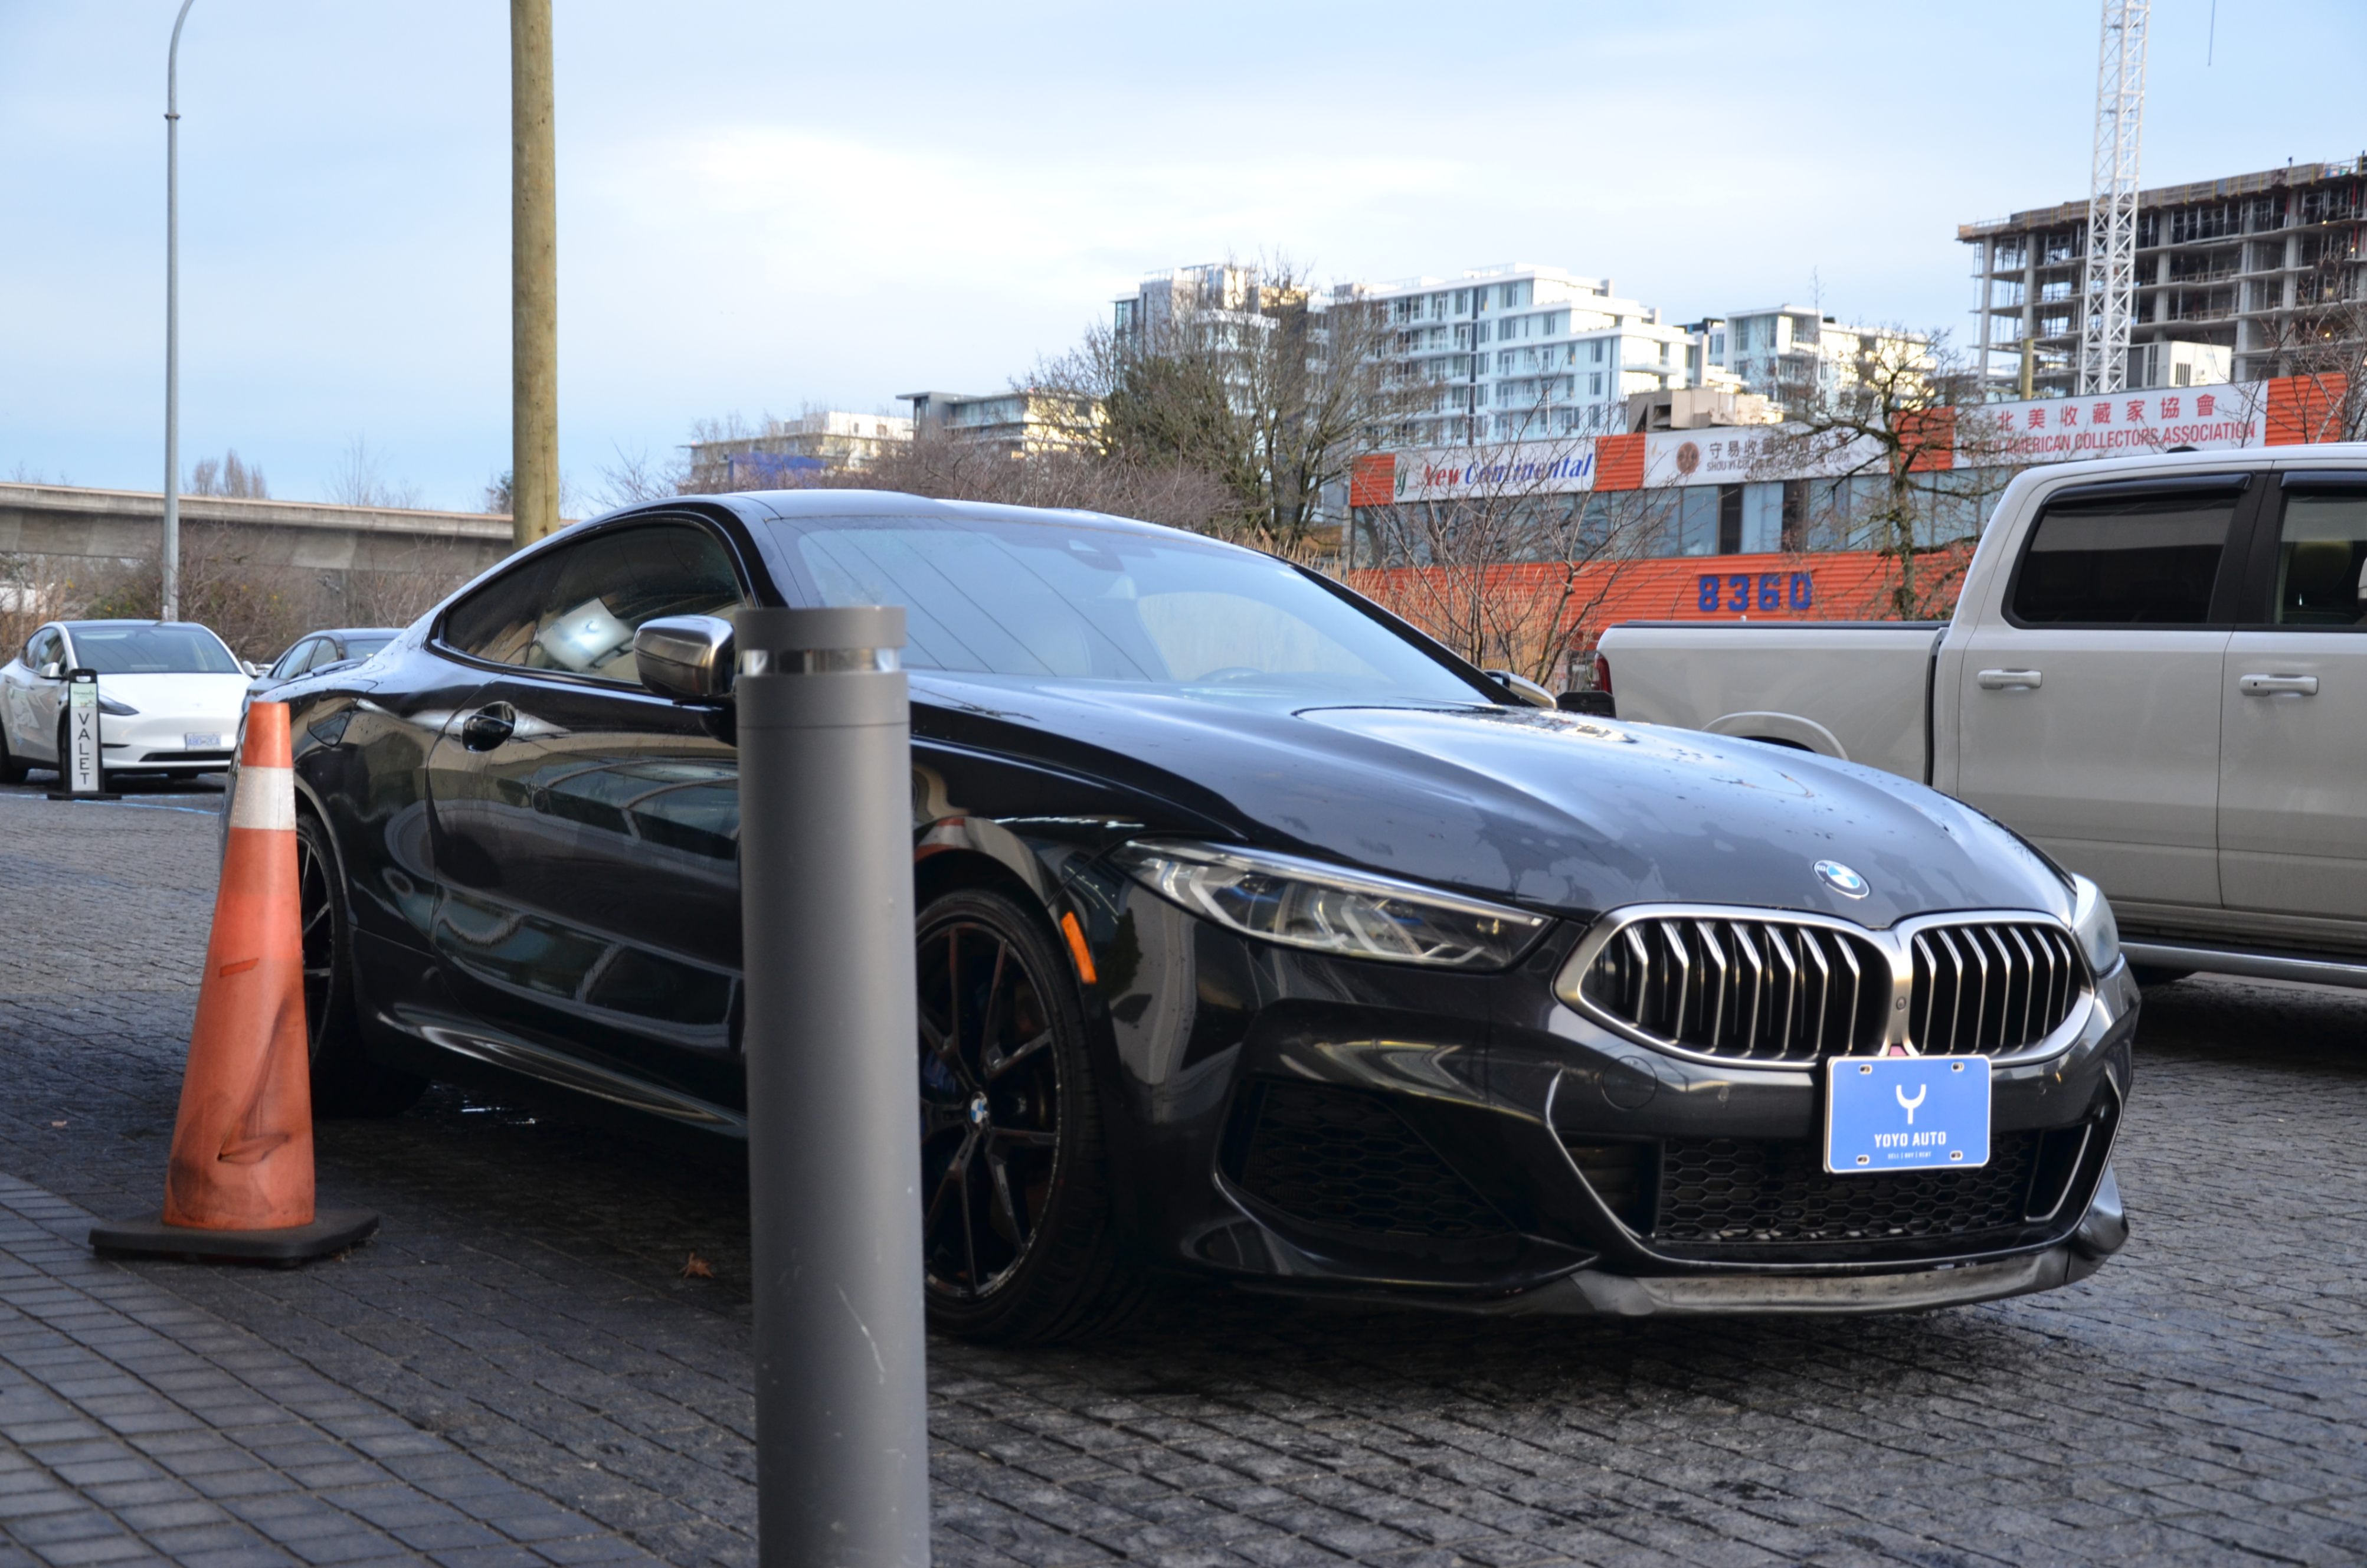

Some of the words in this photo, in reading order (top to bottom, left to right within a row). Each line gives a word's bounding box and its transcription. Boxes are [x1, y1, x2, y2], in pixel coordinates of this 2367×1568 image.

[1998, 394, 2215, 431] 北美收藏家協會
[2006, 434, 2071, 454] AMERICAN
[2075, 428, 2159, 450] COLLECTORS
[2163, 421, 2255, 444] ASSOCIATION
[1698, 572, 1812, 613] 8360
[78, 712, 91, 785] VALET
[1875, 1133, 1908, 1148] YOYO
[1912, 1131, 1946, 1146] AUTO
